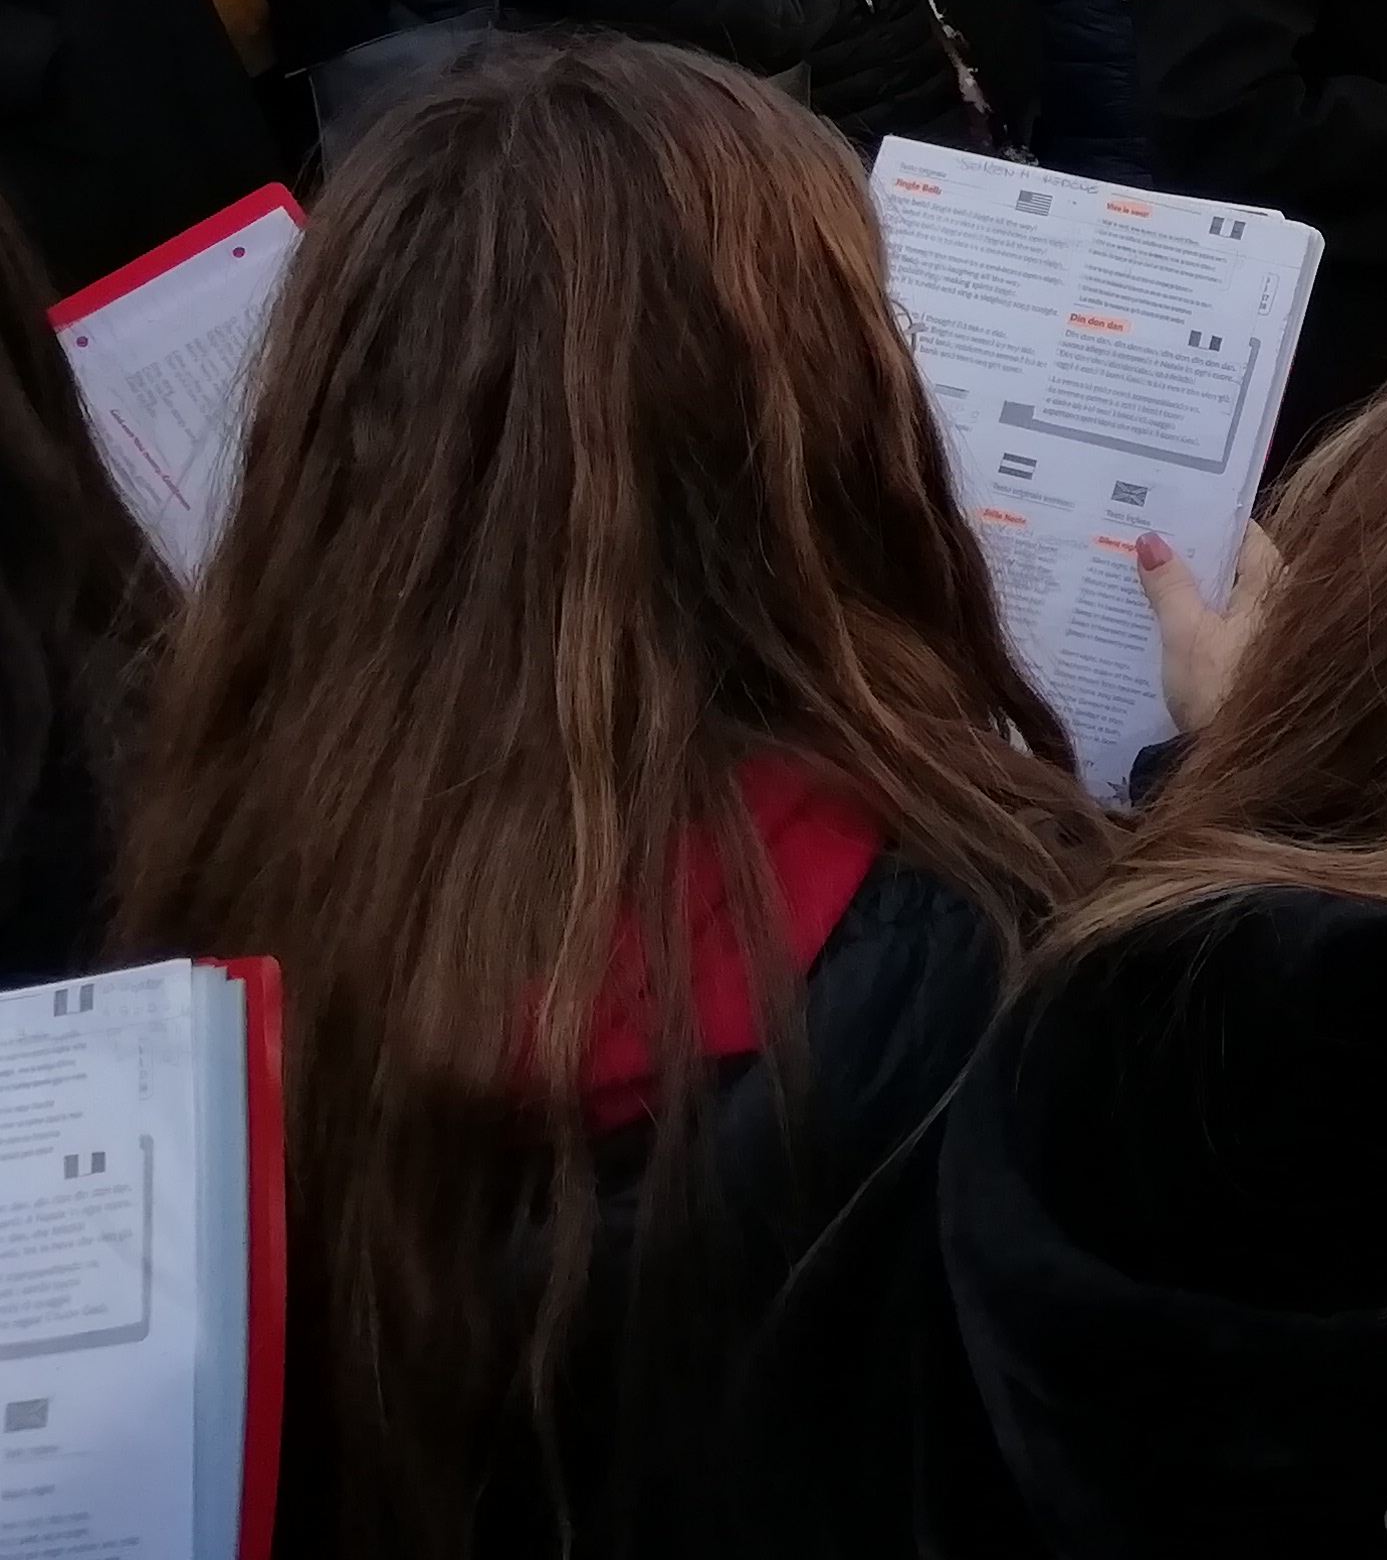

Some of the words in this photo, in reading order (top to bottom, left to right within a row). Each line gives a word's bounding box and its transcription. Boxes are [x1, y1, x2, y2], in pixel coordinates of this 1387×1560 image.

[894, 178, 920, 190] Jingle
[1069, 313, 1086, 323] Din
[1087, 317, 1105, 327] don
[1106, 321, 1123, 331] dan
